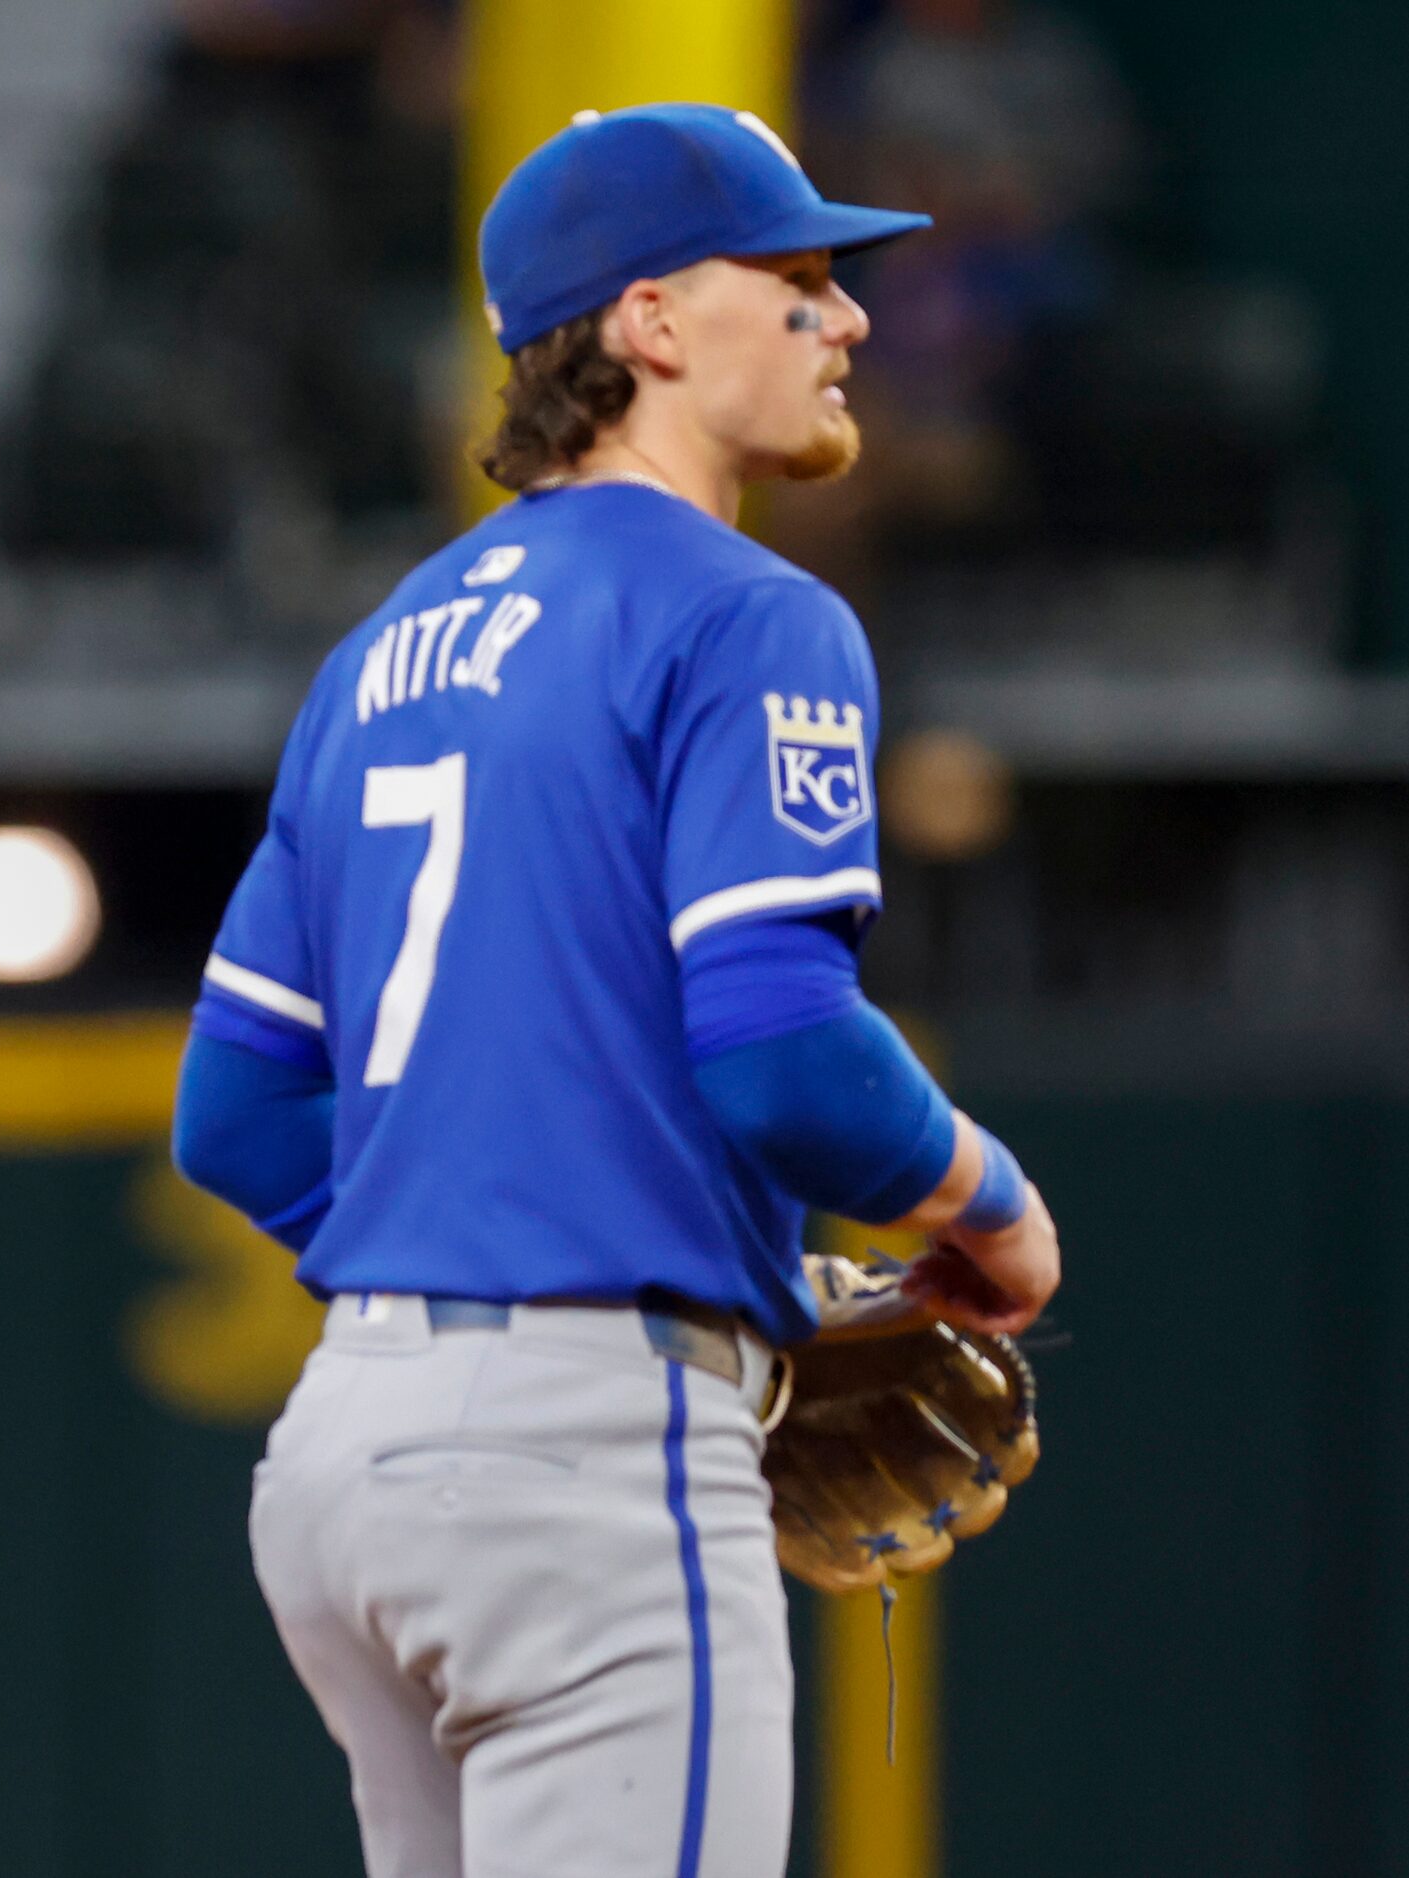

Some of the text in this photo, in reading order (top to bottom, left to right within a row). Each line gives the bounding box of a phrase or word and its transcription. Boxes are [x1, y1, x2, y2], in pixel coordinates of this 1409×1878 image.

[356, 596, 485, 725] WITT
[779, 745, 861, 820] KC
[361, 751, 467, 1088] 7
